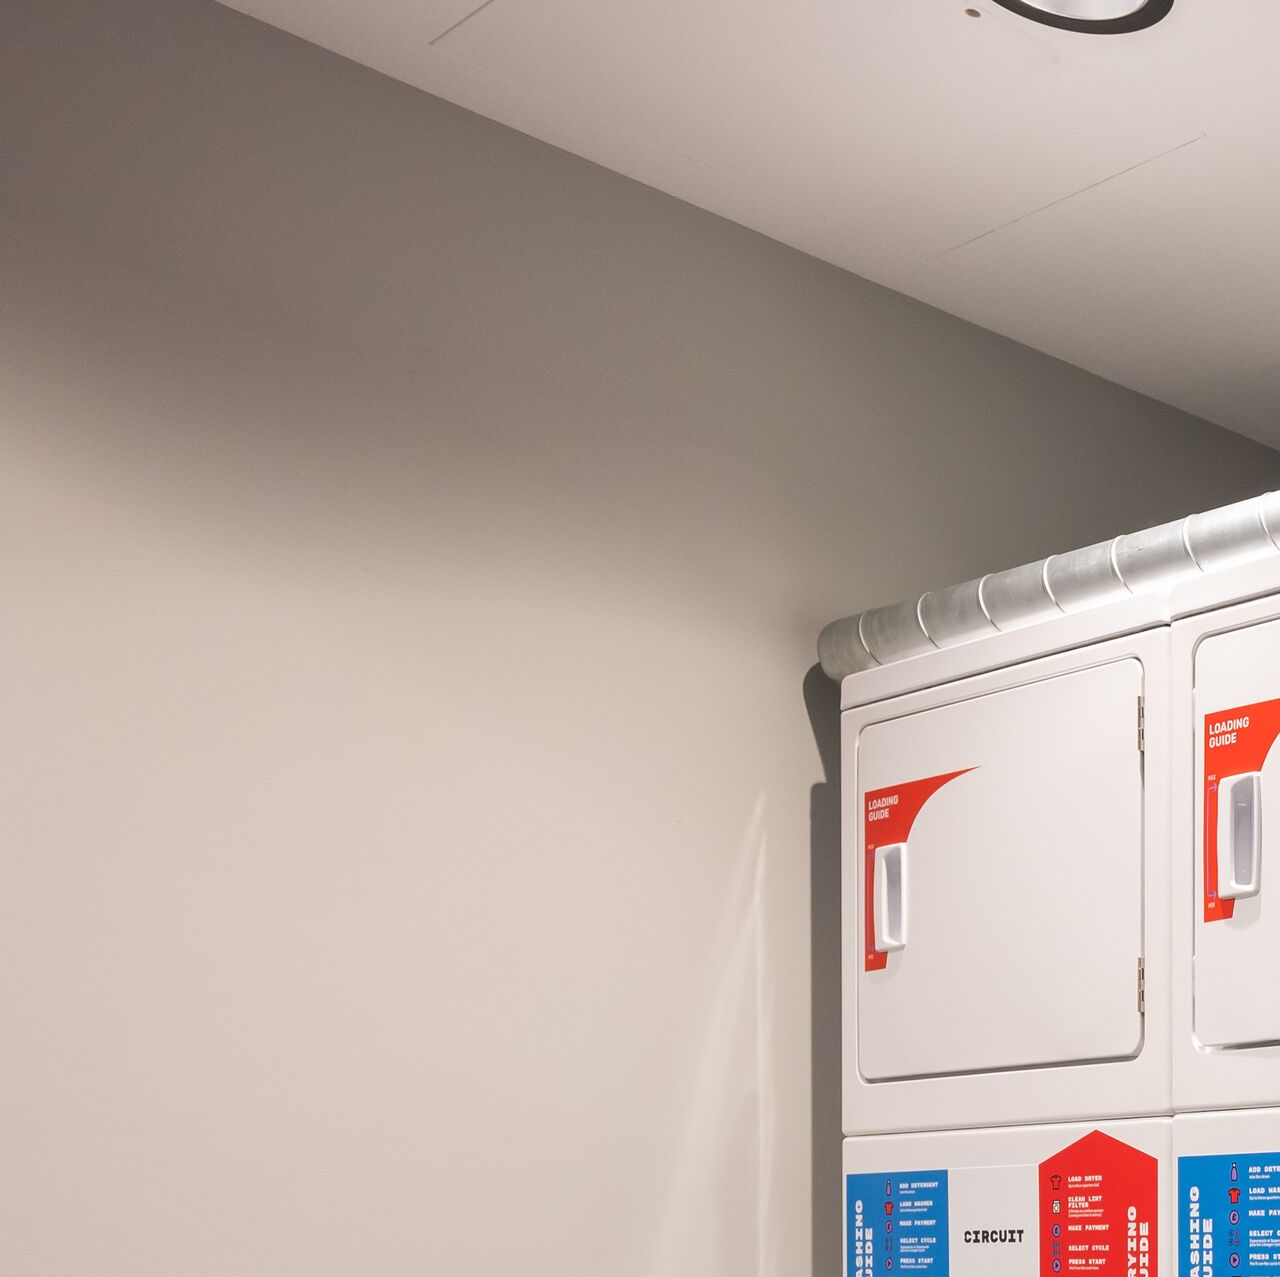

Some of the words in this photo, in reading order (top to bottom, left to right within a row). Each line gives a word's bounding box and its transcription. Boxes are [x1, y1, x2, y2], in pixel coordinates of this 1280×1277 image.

[1209, 716, 1249, 735] LOADING
[1209, 732, 1236, 748] GUIDE
[868, 794, 898, 810] LOADING
[868, 808, 889, 822] GUIDE
[964, 1229, 1024, 1243] CIRCUIT
